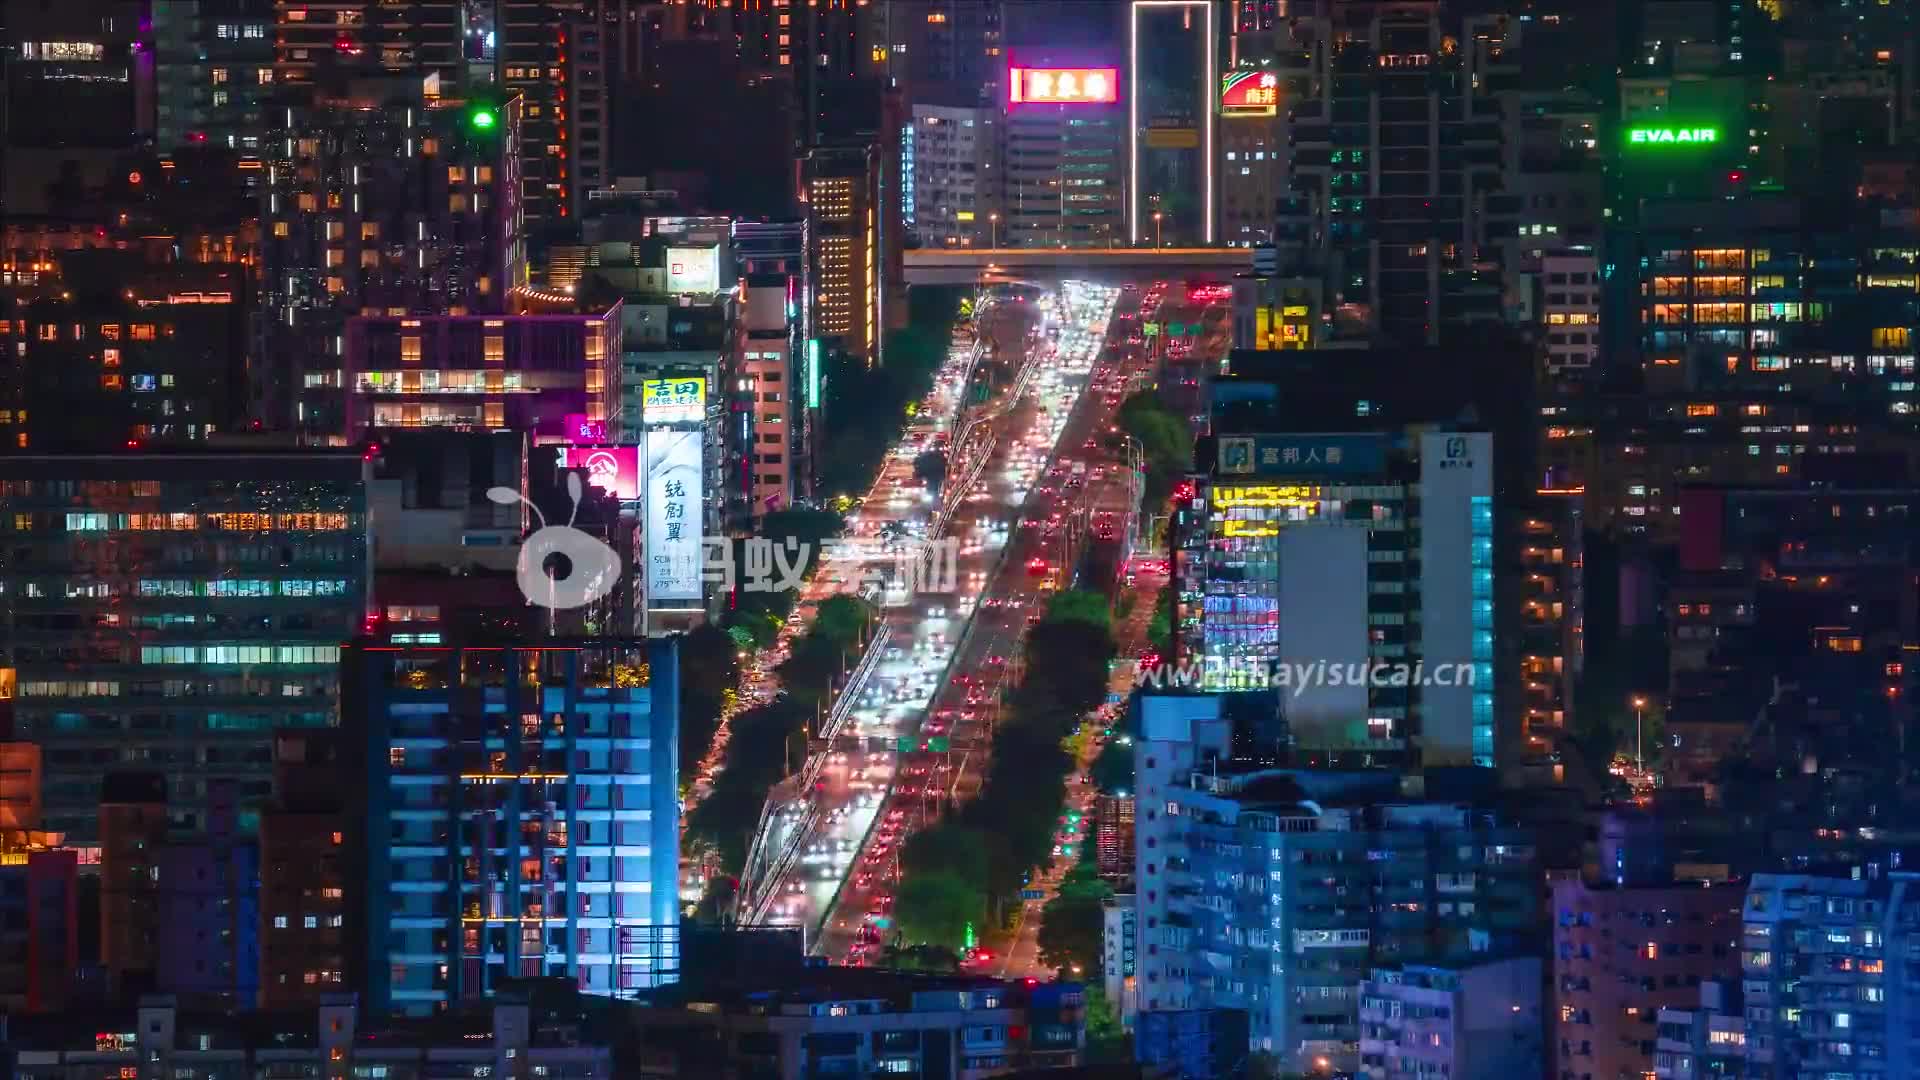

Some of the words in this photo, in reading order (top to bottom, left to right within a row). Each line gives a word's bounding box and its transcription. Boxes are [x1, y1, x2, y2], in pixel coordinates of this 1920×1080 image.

[1631, 129, 1675, 142] EVA
[1676, 129, 1716, 142] AIR
[647, 379, 700, 397] 吉田
